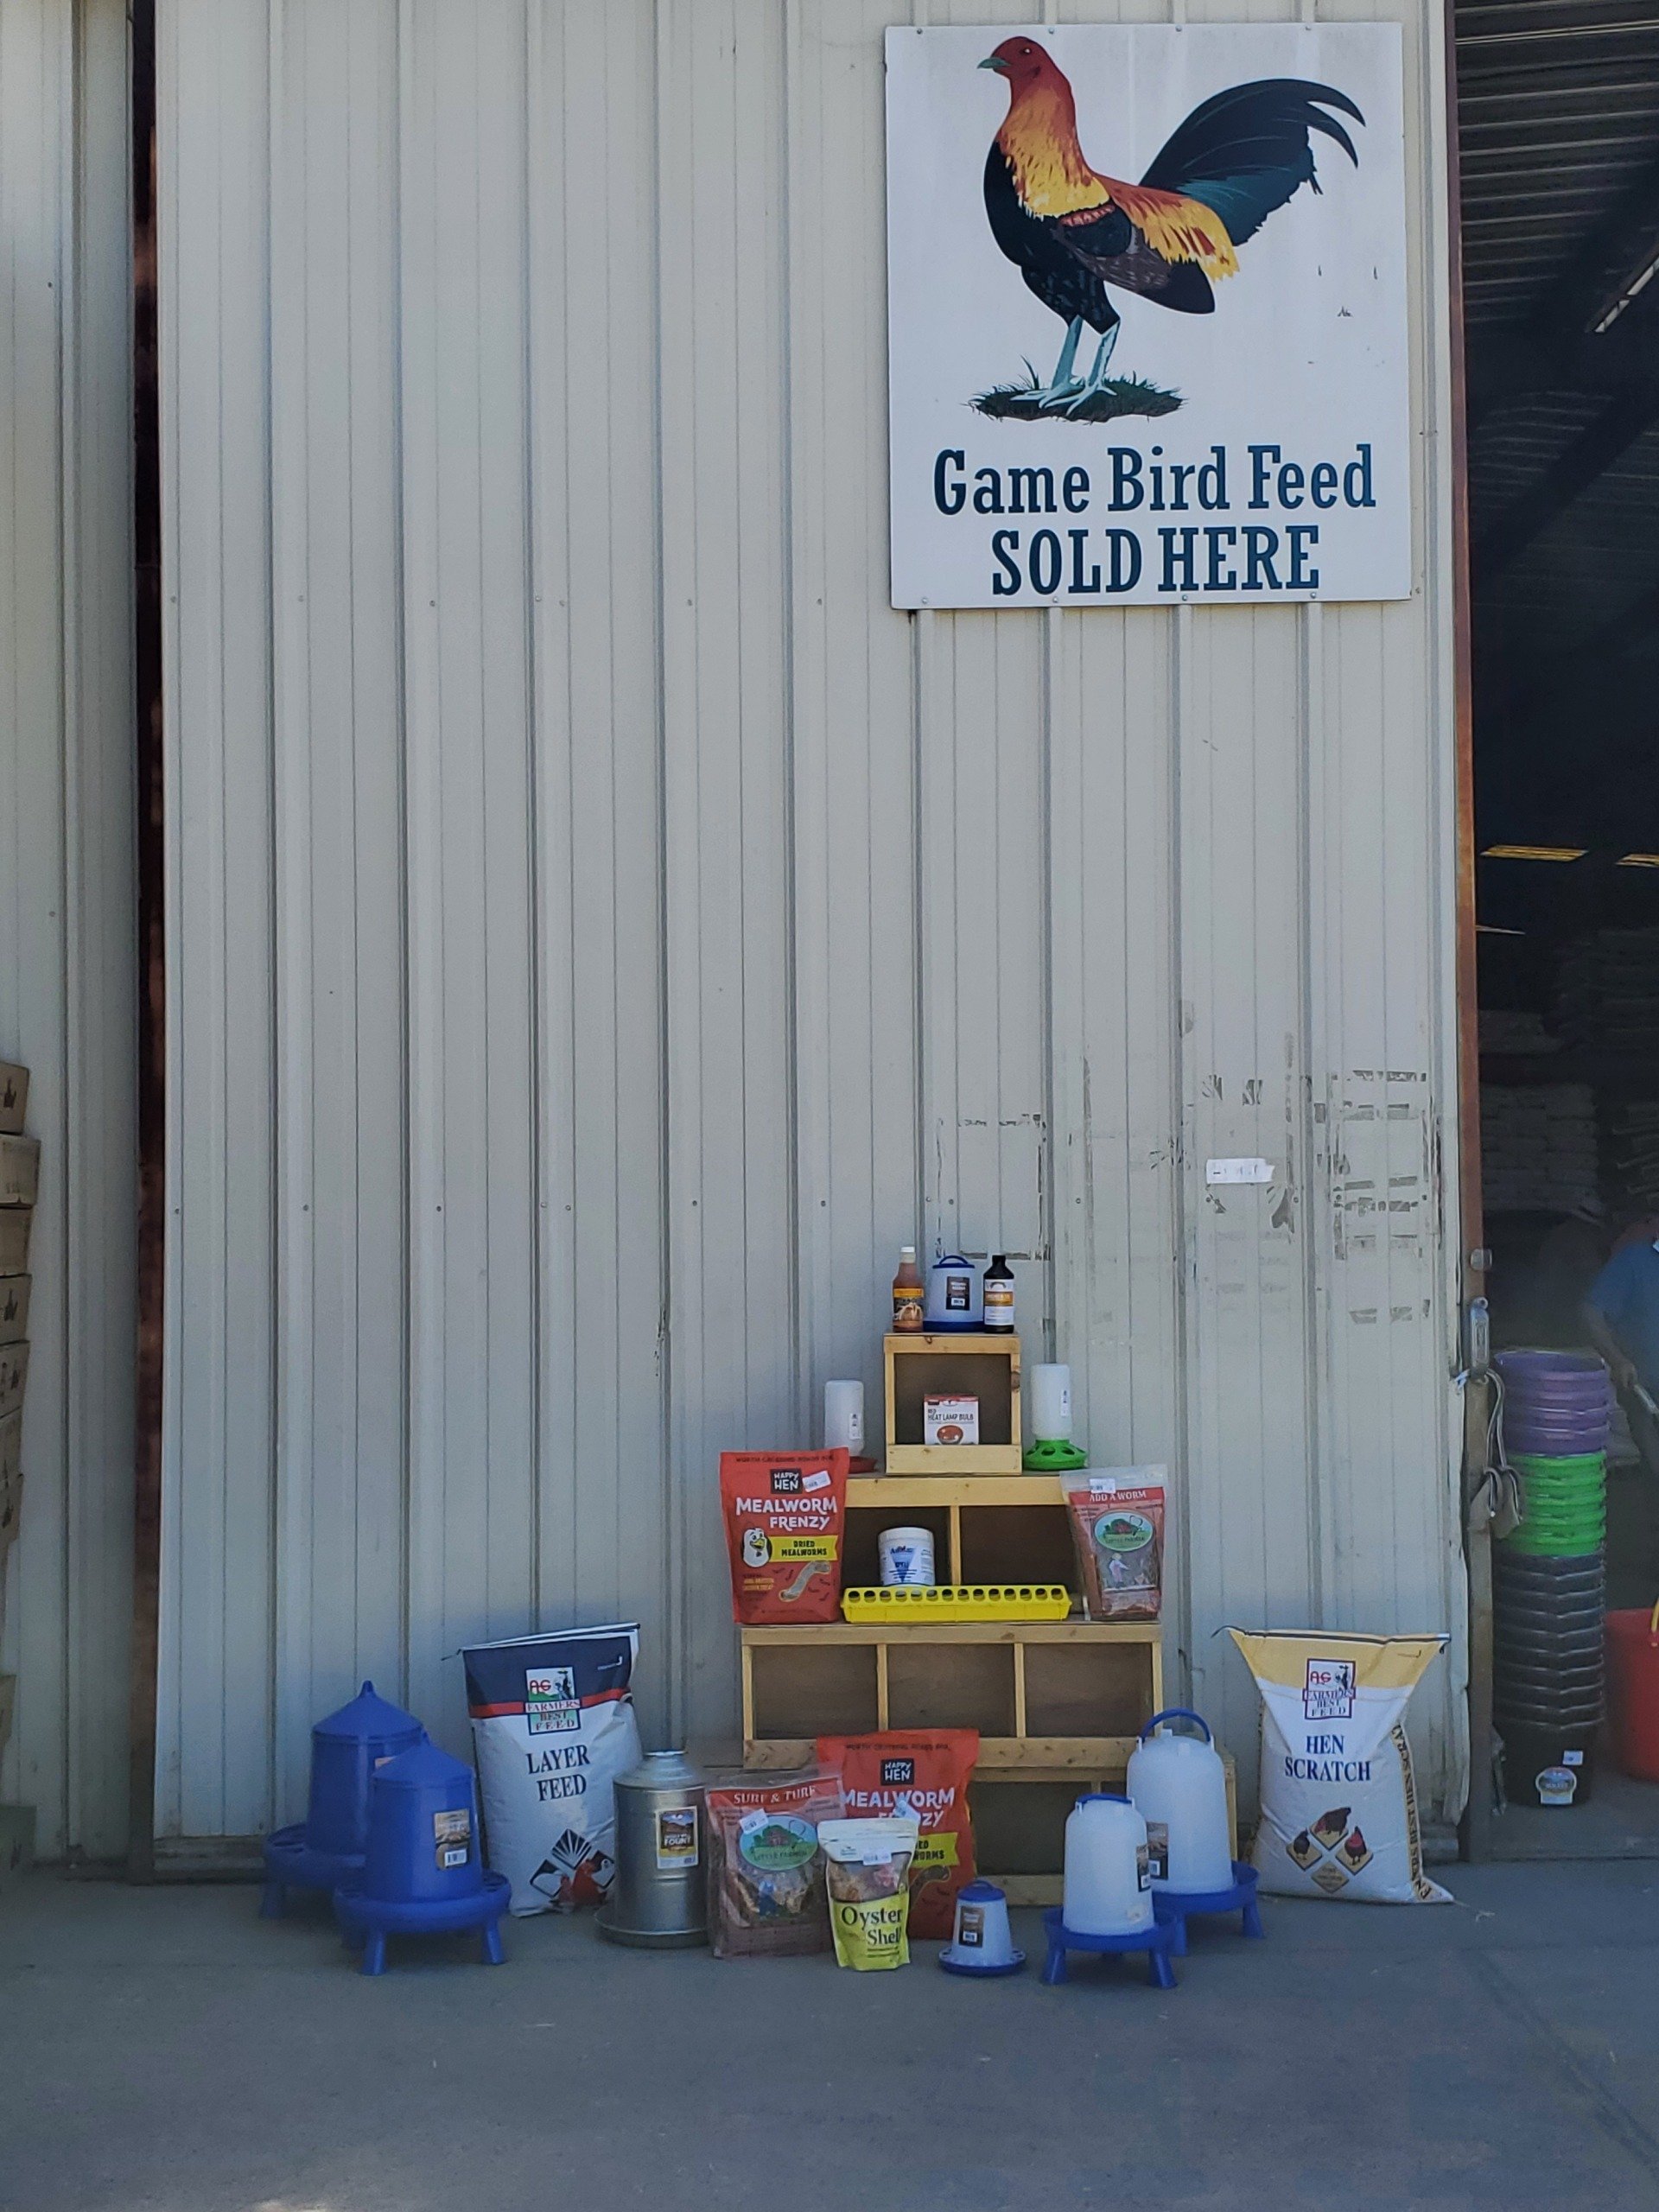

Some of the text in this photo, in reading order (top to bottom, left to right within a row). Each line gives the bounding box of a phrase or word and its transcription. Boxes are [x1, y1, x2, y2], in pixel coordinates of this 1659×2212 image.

[933, 443, 1376, 515] Game Bird Feed
[992, 524, 1319, 595] SOLD HERE
[773, 1479, 799, 1491] HEN
[735, 1496, 838, 1516] MEALWORM
[1089, 1491, 1147, 1503] ADD A WORM
[769, 1516, 830, 1532] FRENZY
[781, 1548, 828, 1557] MEALWORMS
[793, 1540, 816, 1548] DRIED
[530, 1680, 551, 1694] AG
[1311, 1671, 1332, 1684] AG
[527, 1700, 580, 1712] FARMERS
[540, 1711, 567, 1721] BEST
[1306, 1734, 1344, 1754] HEN
[525, 1745, 590, 1775] LAYER
[1285, 1756, 1371, 1782] SCRATCH
[884, 1770, 911, 1781] HEN
[537, 1774, 587, 1802] FEED
[734, 1785, 816, 1804] SURF & TURF
[840, 1787, 955, 1809] MEALWORM
[842, 1905, 903, 1931] Oyster
[867, 1926, 902, 1946] Shell
